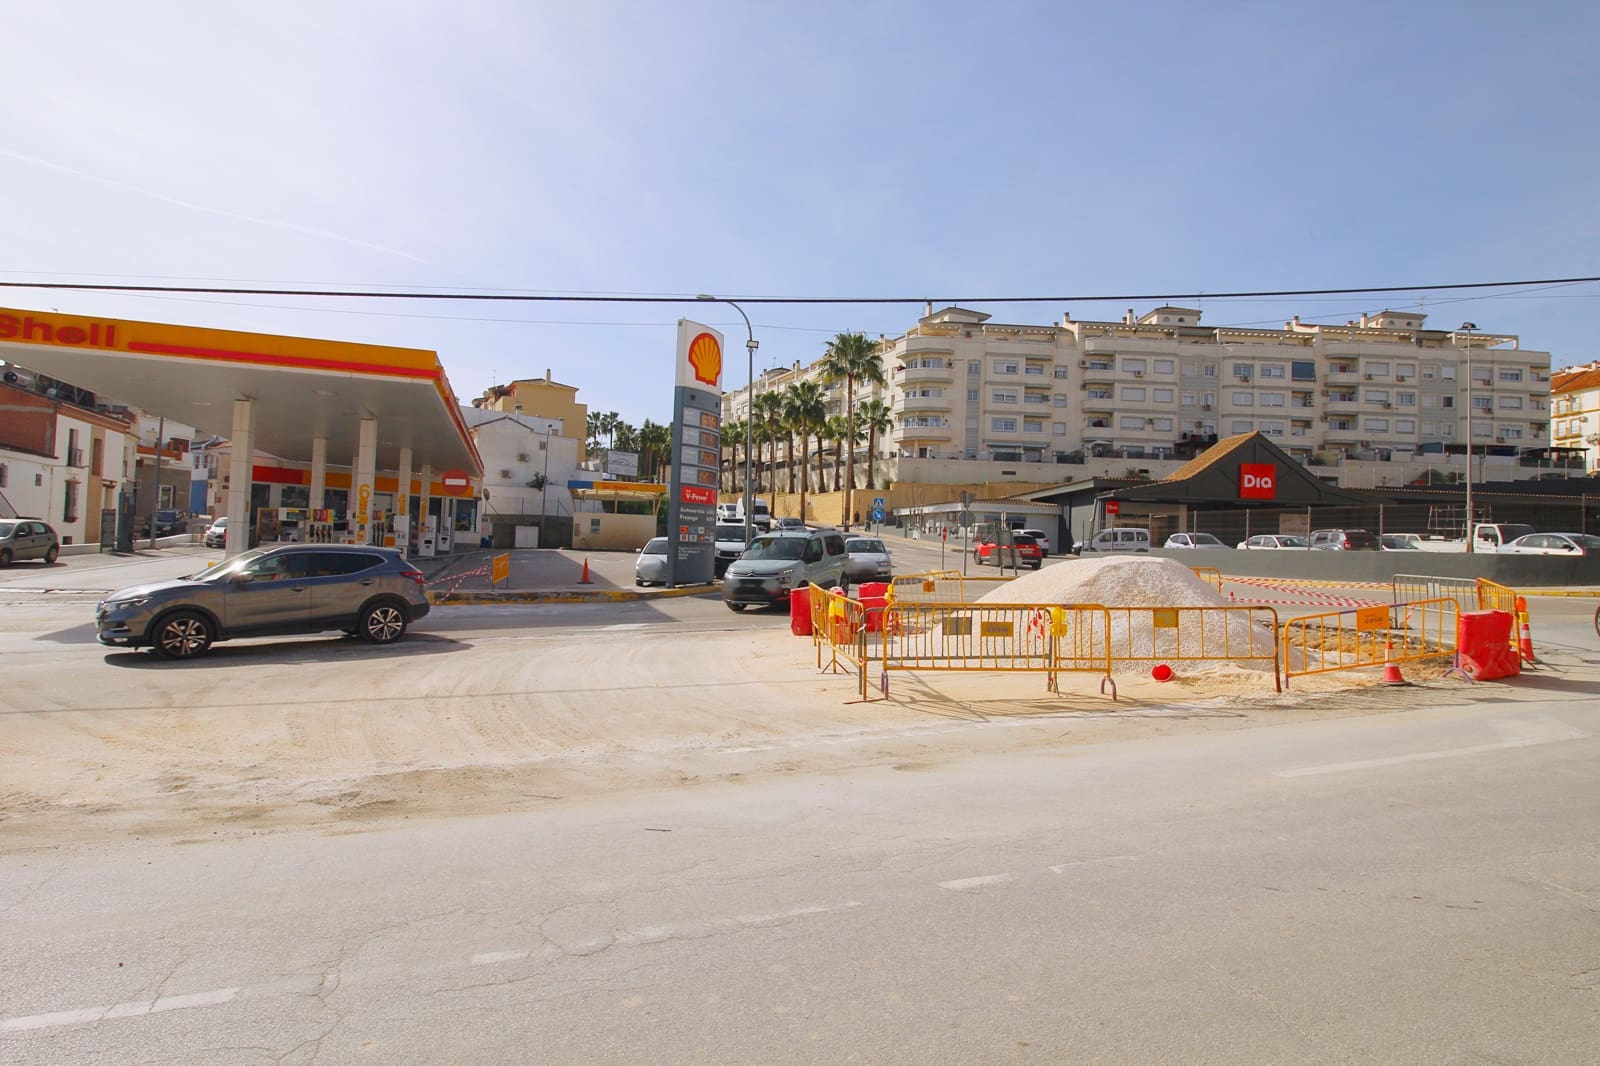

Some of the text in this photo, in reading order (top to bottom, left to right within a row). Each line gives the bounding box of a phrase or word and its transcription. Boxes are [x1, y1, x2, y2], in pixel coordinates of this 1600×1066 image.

[0, 314, 116, 347] Shell
[1244, 474, 1272, 489] Dia
[359, 483, 370, 499] 6
[685, 491, 708, 502] V-Power
